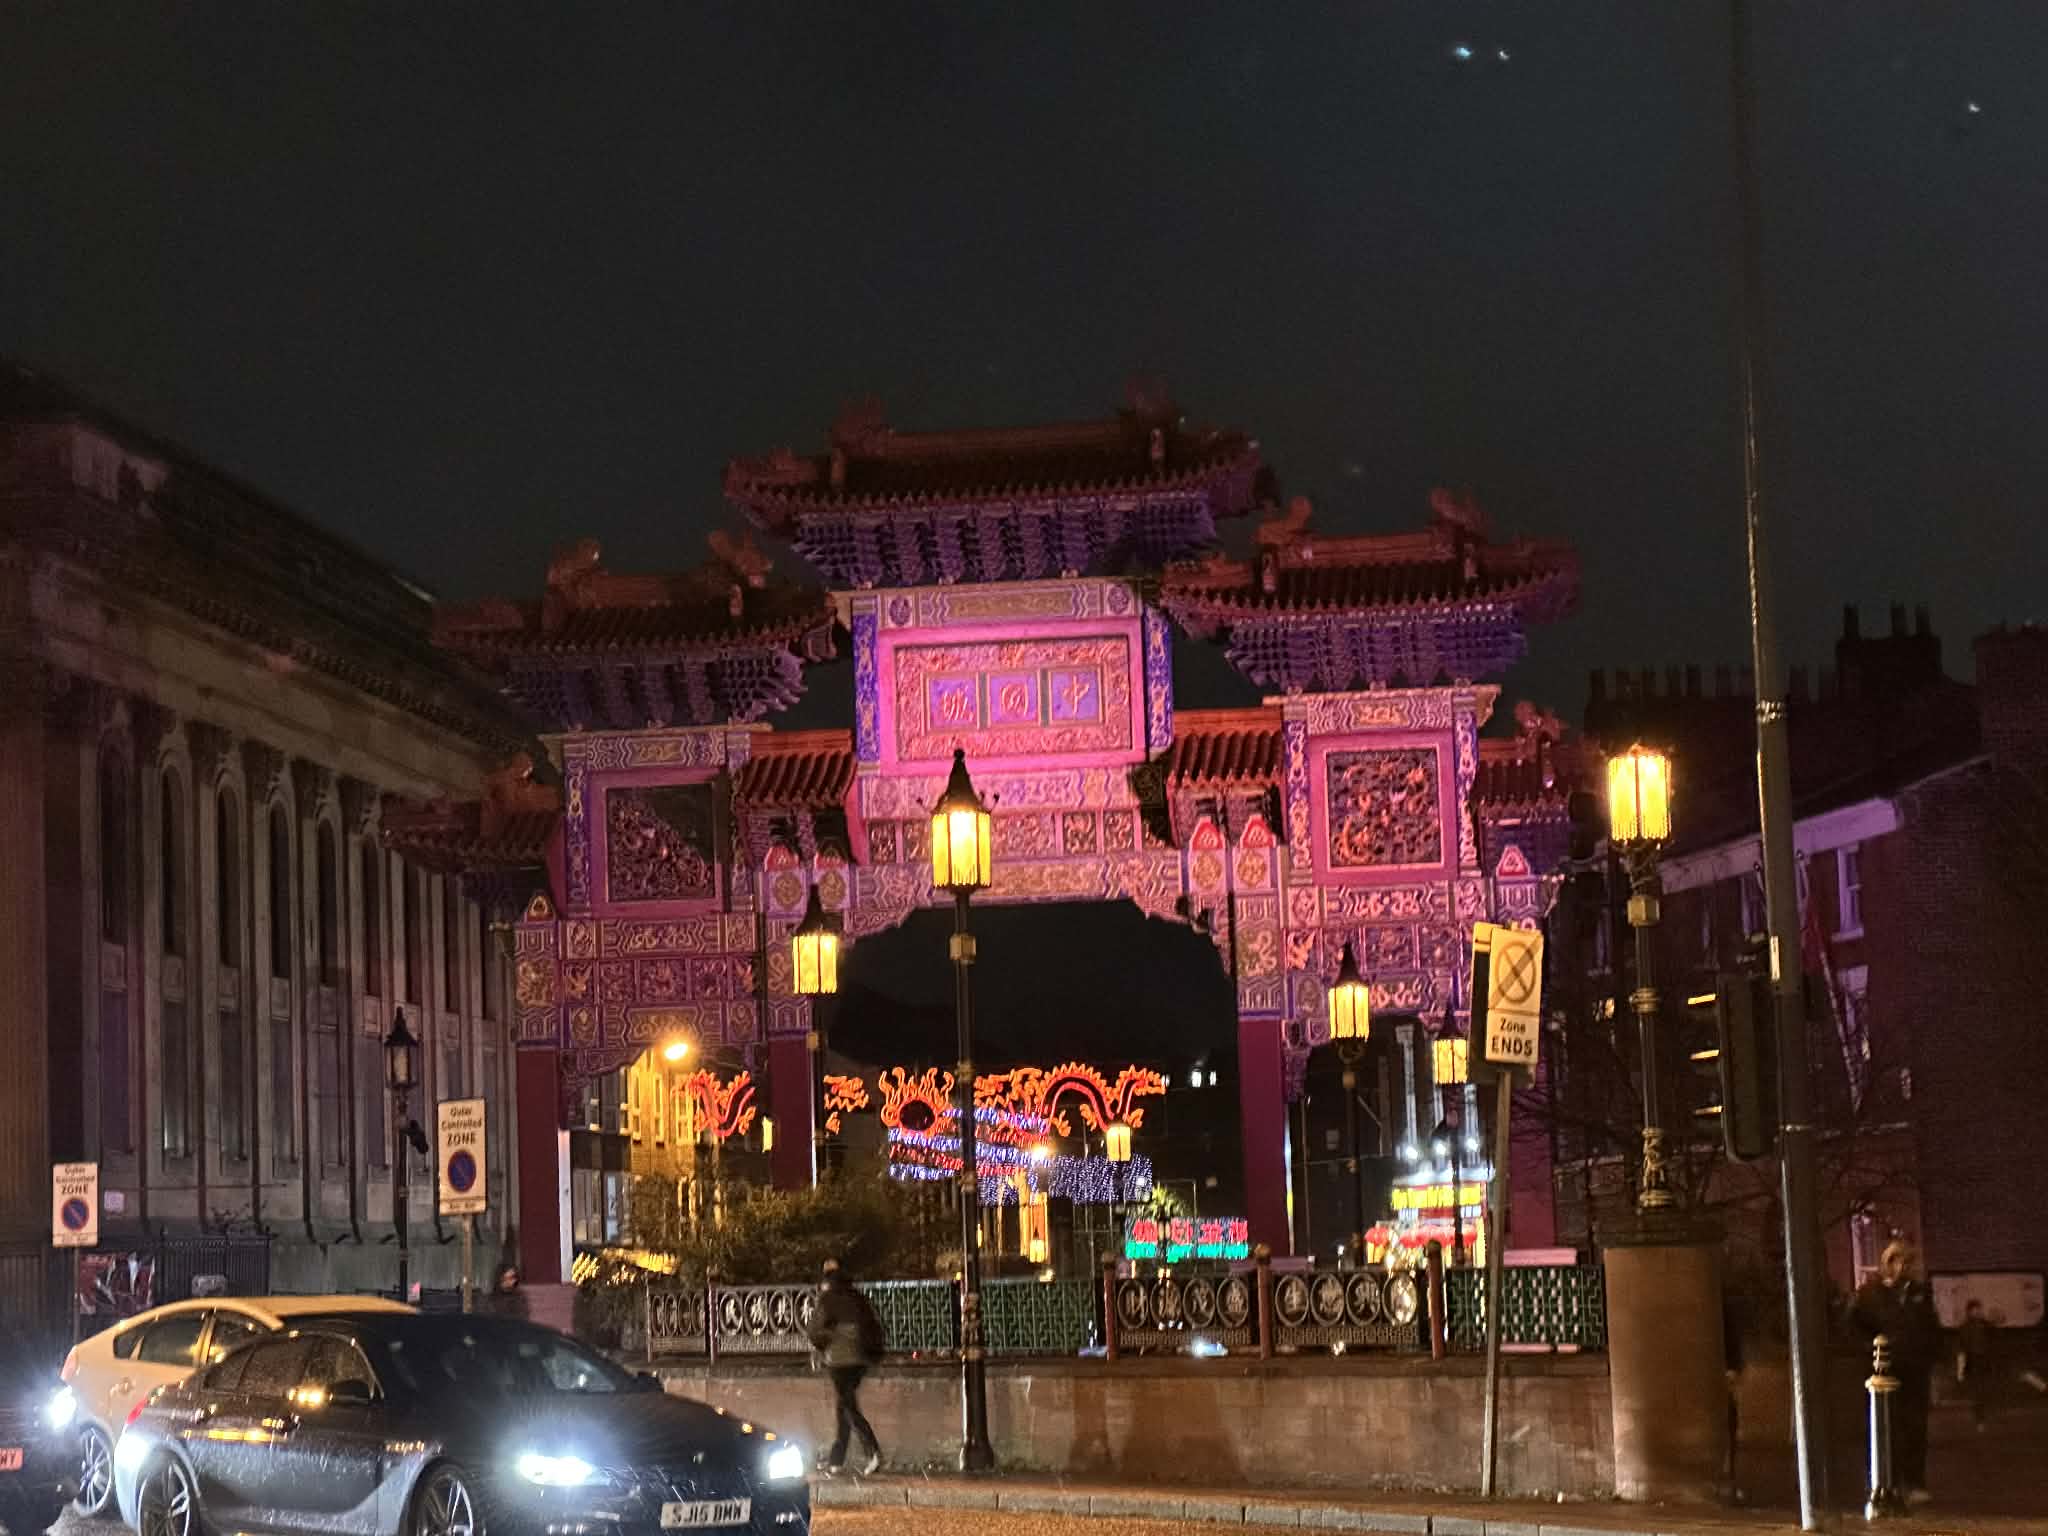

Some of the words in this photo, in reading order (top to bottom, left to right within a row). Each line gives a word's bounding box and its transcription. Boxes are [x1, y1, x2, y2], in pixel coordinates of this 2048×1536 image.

[1500, 1018, 1527, 1034] Zone
[1491, 1035, 1533, 1058] ENDS
[441, 1117, 482, 1131] Controlled
[447, 1132, 477, 1146] ZONE
[61, 1184, 88, 1195] ZONE
